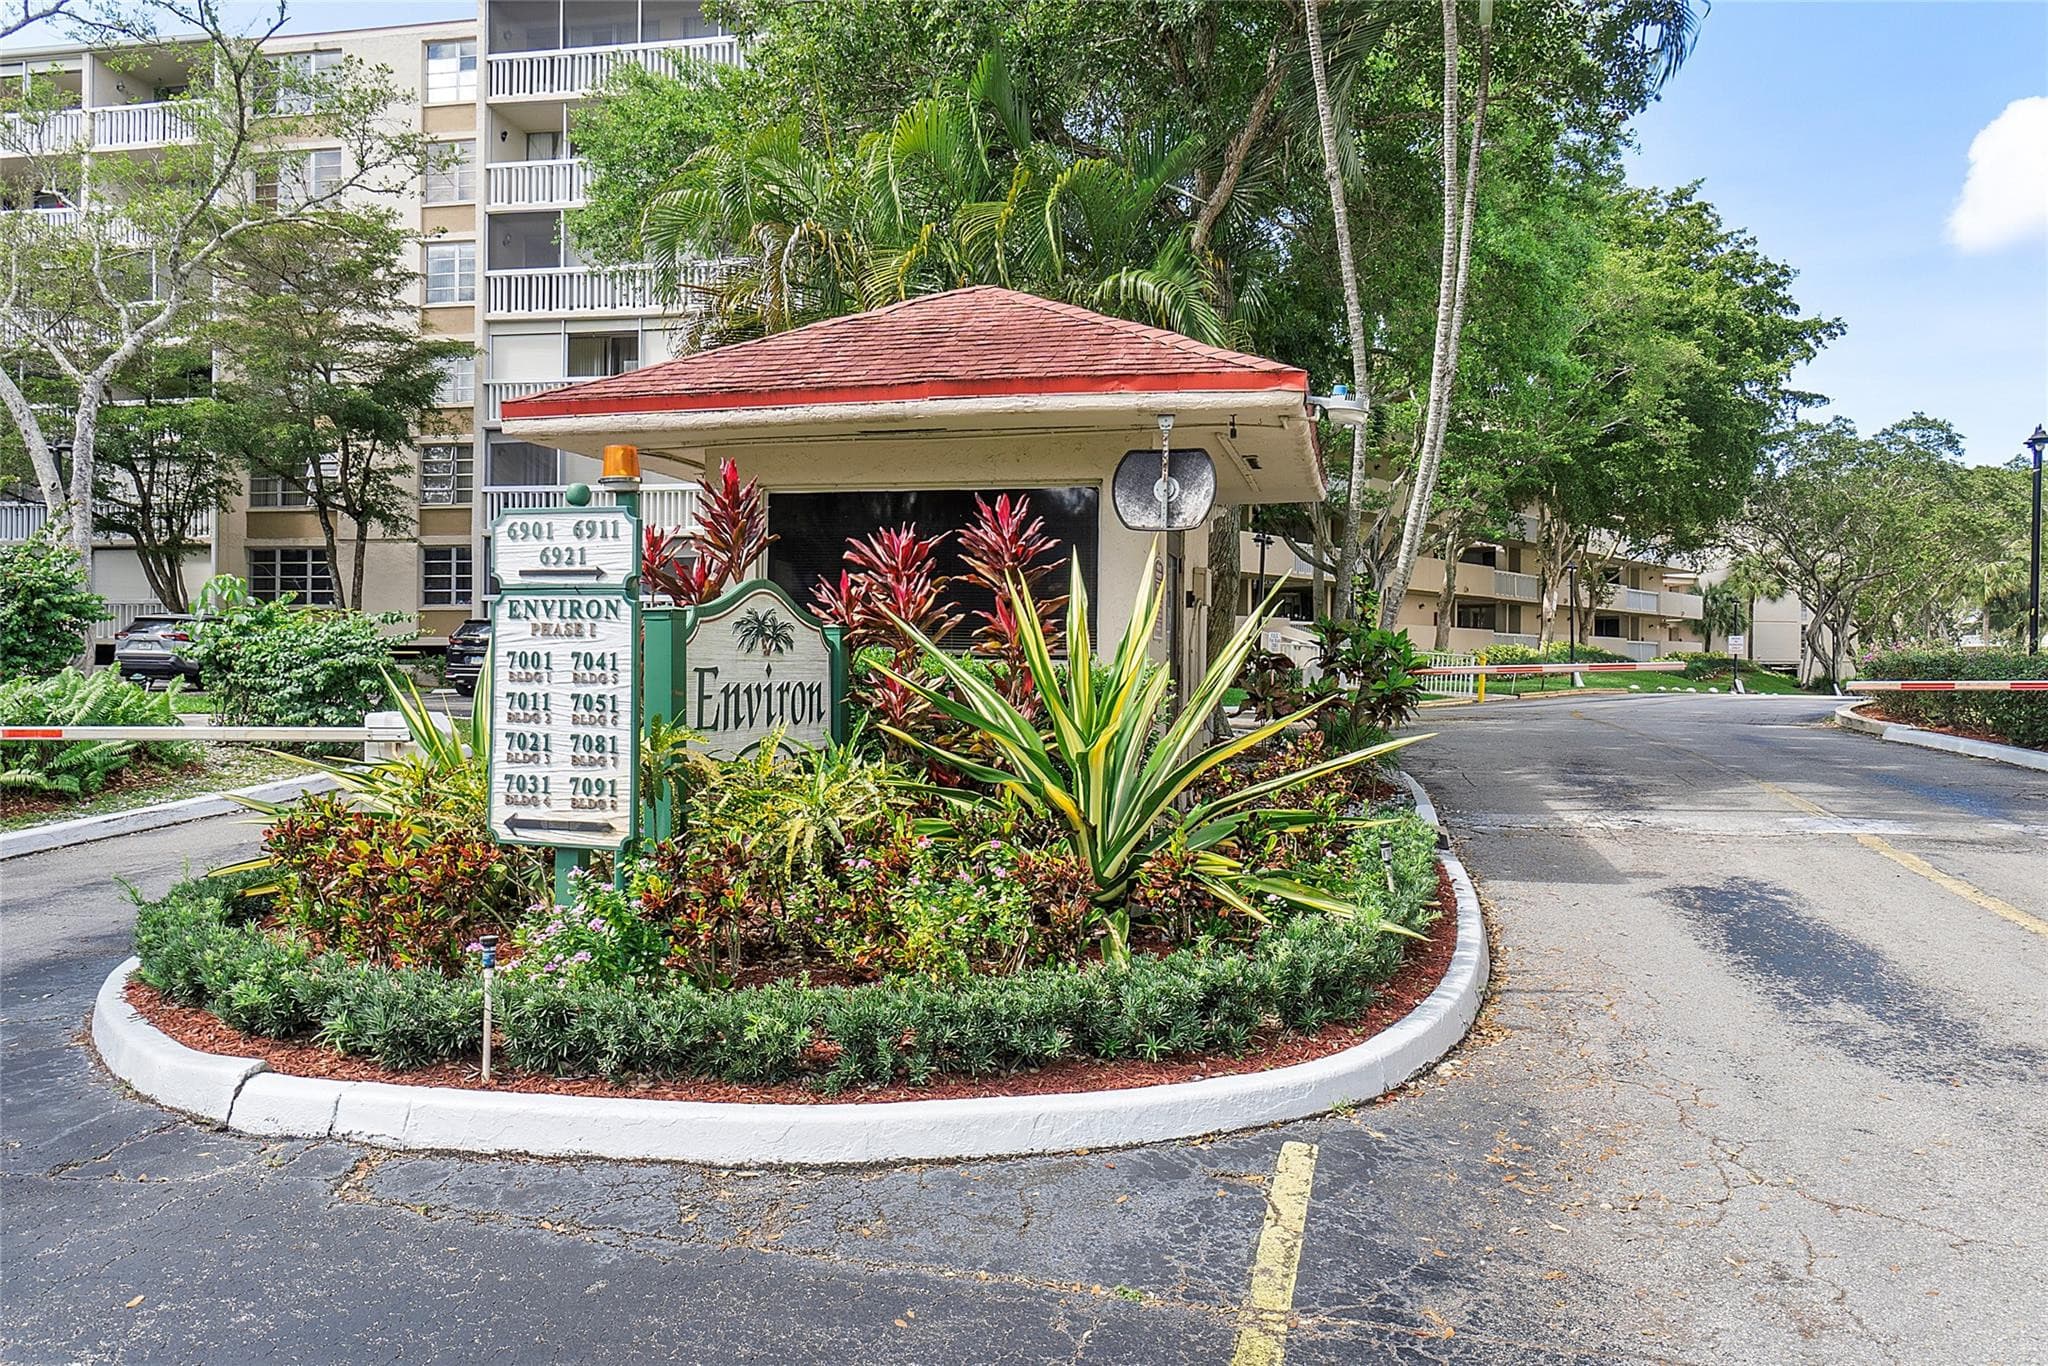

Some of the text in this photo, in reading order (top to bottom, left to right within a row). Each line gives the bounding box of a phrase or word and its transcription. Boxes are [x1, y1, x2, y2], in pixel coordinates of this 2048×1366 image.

[507, 520, 620, 540] 6901 6911
[540, 546, 587, 565] 6921
[508, 599, 621, 619] ENVIRON
[531, 623, 583, 637] PHASE
[507, 651, 552, 670] 7001
[571, 651, 618, 671] 7041
[508, 671, 552, 683] BLDG 1
[572, 673, 619, 685] BLDG 5
[506, 692, 551, 711] 7011
[571, 694, 618, 713] 7051
[693, 662, 826, 732] Environ
[506, 712, 541, 724] BLDG
[572, 714, 618, 726] BLDG 6
[505, 732, 551, 752] 7021
[570, 734, 618, 754] 7081
[506, 752, 551, 765] BLDG 3
[571, 755, 607, 767] BLDG
[504, 774, 551, 794] 7031
[569, 777, 617, 797] 7091
[505, 795, 540, 806] BLDG
[571, 798, 606, 810] BLDG
